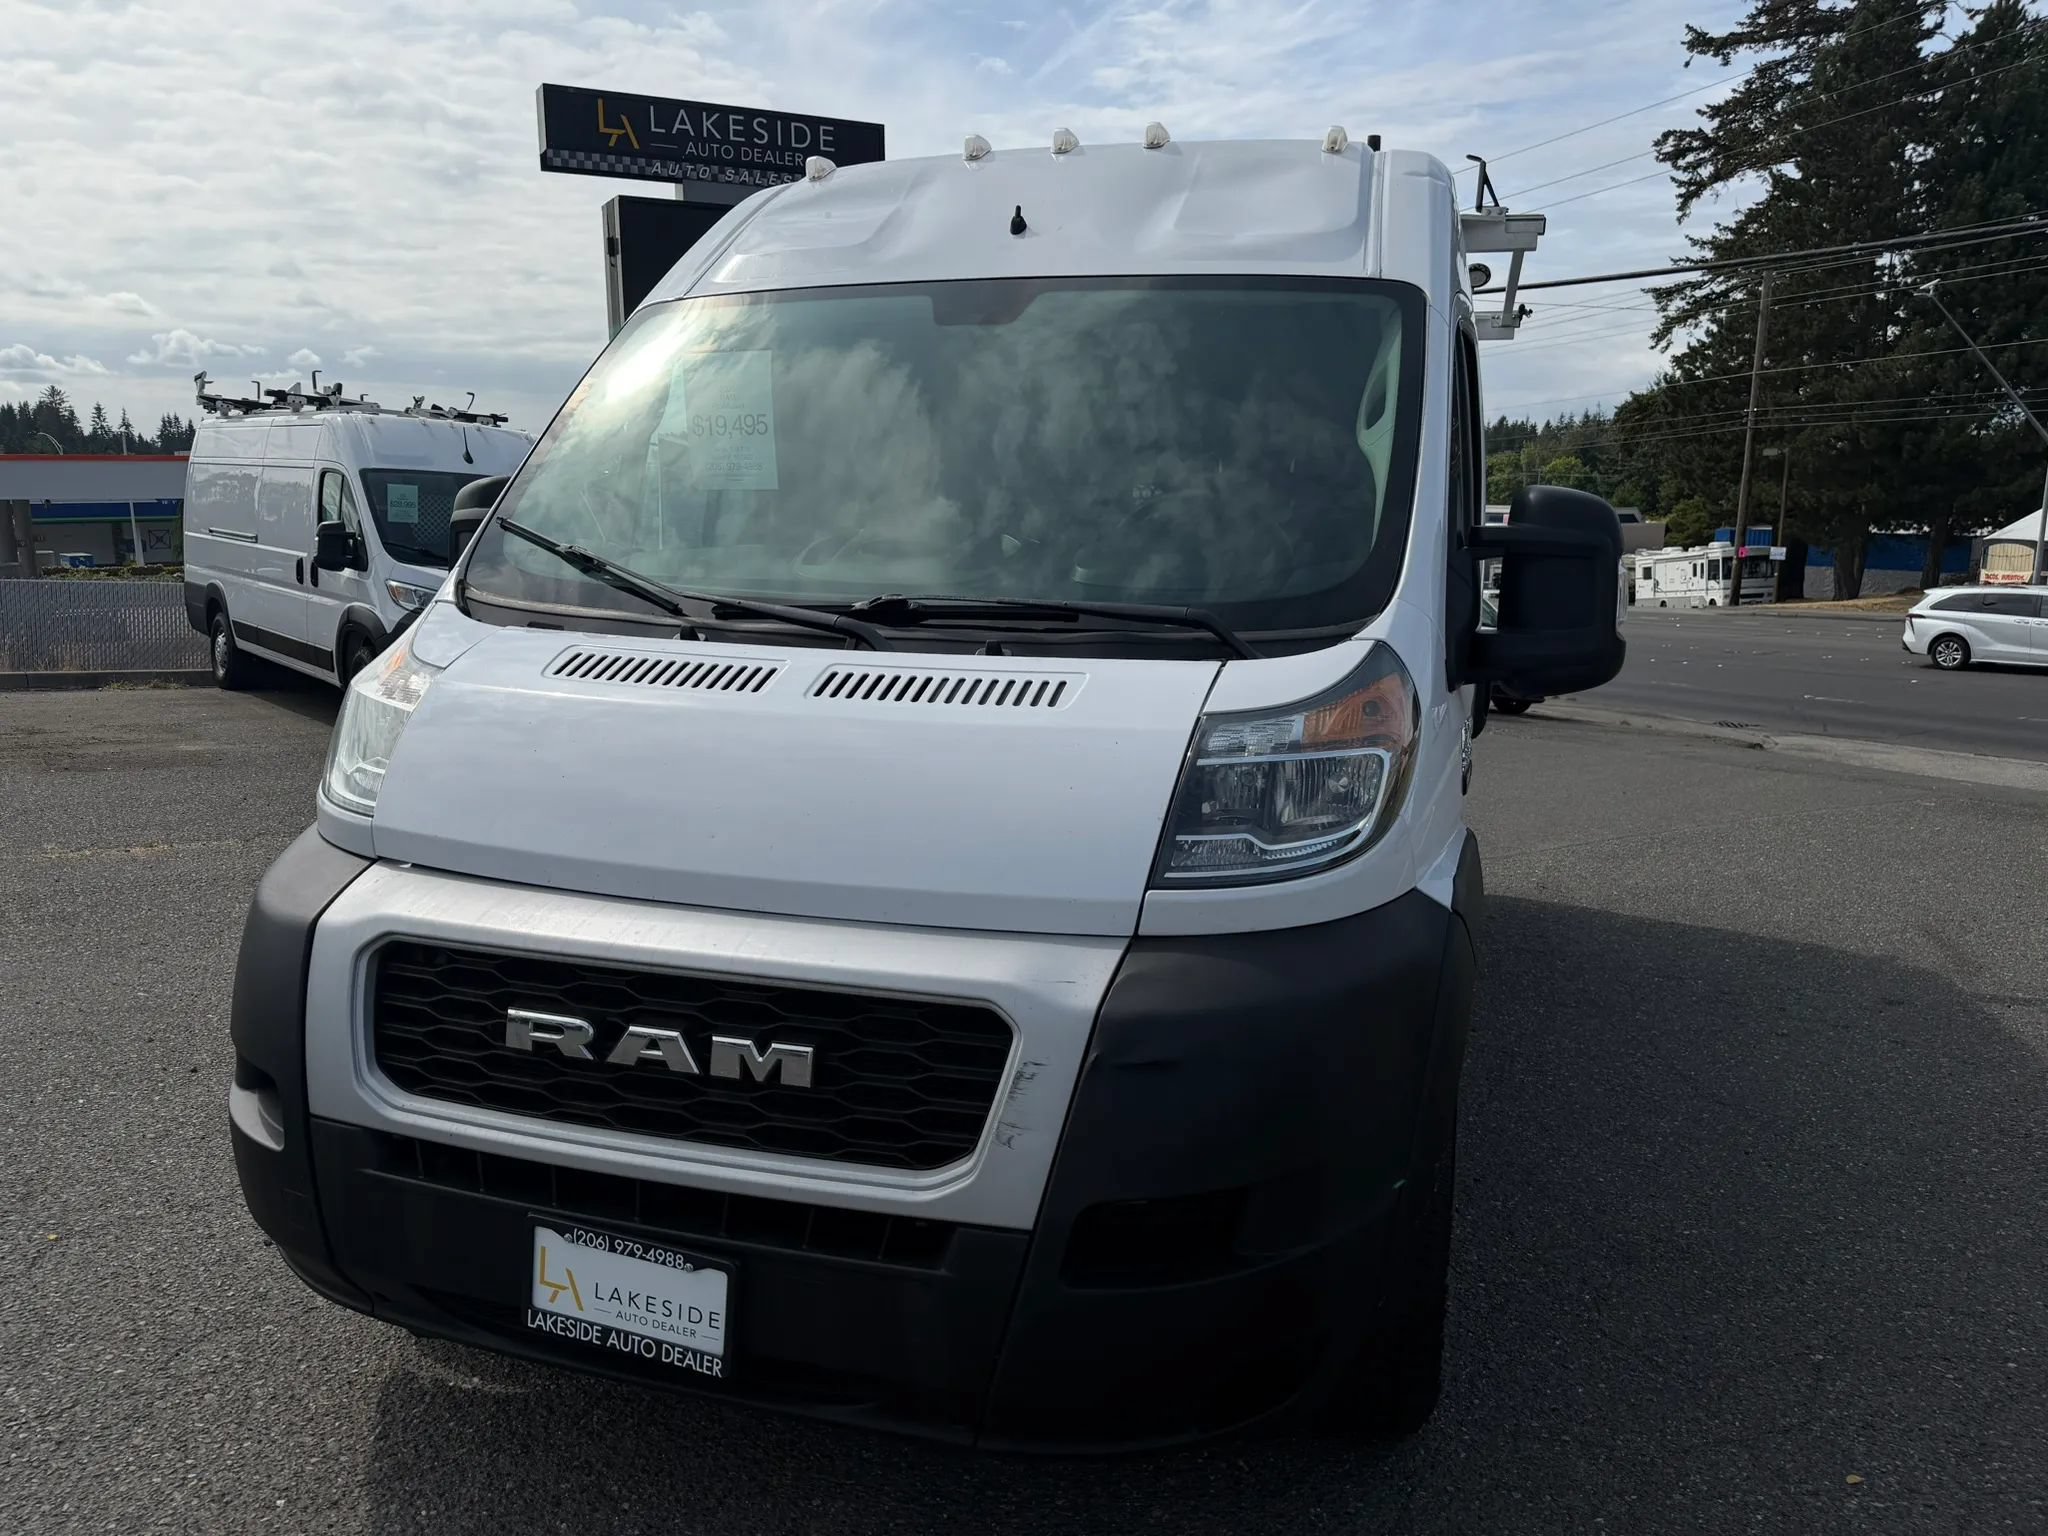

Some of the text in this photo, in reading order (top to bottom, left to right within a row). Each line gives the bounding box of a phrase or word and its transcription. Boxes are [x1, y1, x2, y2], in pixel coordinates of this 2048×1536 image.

[650, 105, 836, 152] LAKESIDE
[651, 162, 793, 186] AUTO SALES
[685, 142, 804, 167] AUTO DEALER
[692, 413, 769, 439] $19,495
[505, 1008, 814, 1088] RAM
[573, 1228, 684, 1270] (206) 979-4988
[595, 1282, 720, 1330] LAKESIDE
[615, 1310, 697, 1339] AUTO DEALER
[527, 1309, 723, 1378] LAKESIDE AUTO DEALER
